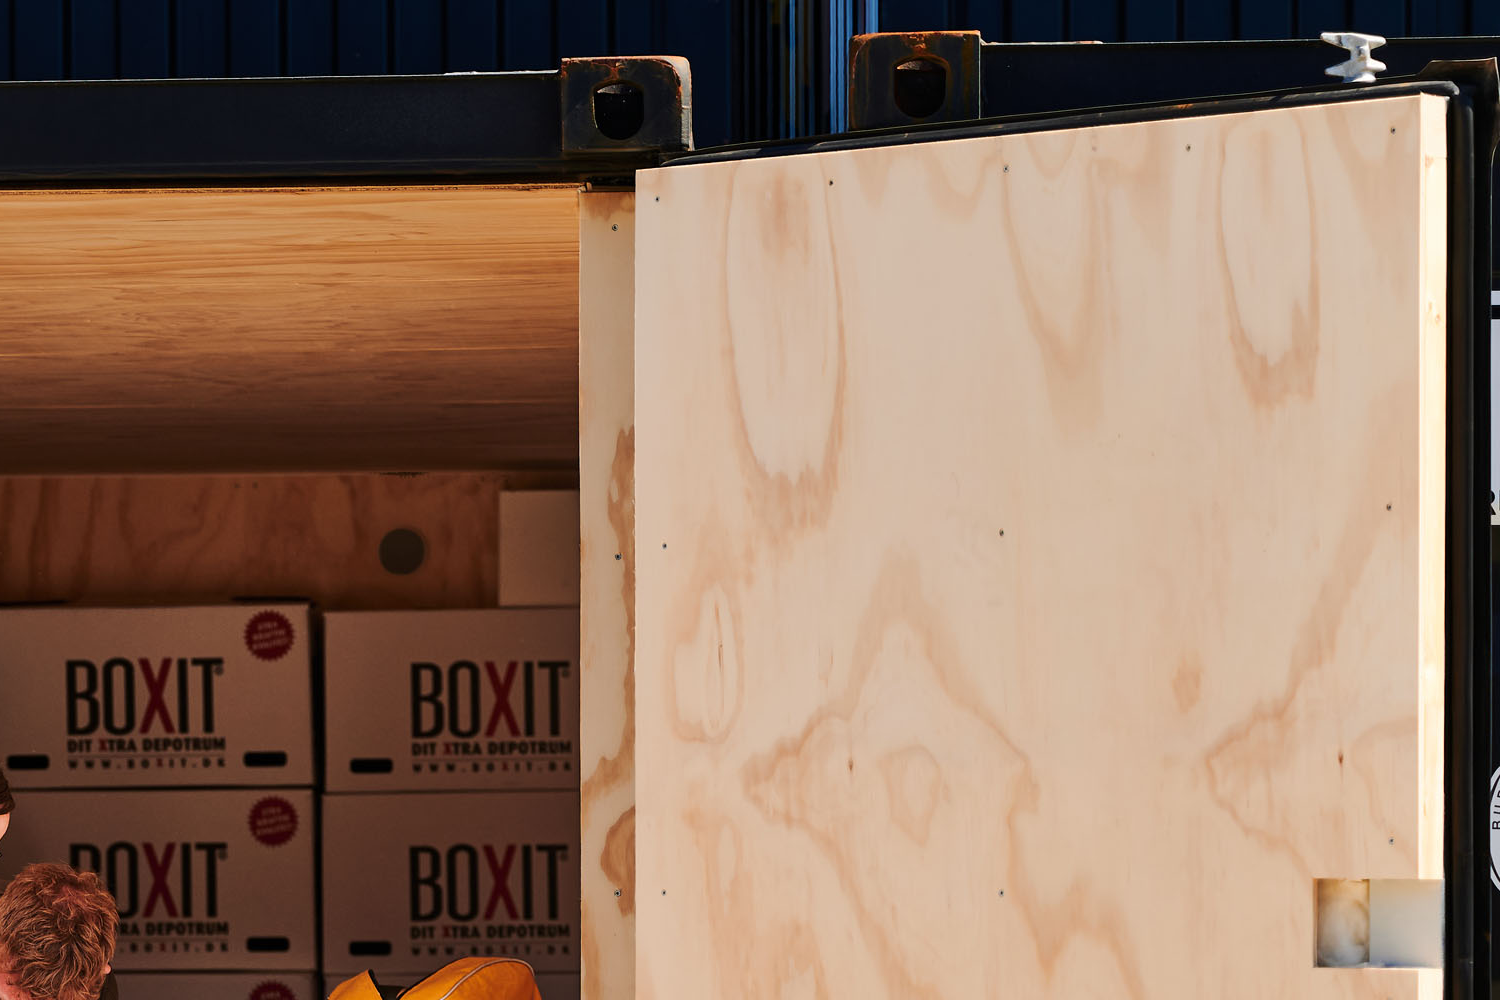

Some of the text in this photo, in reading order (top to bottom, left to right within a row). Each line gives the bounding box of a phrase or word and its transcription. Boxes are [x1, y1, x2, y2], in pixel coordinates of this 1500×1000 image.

[67, 738, 225, 753] DIT XTRA DEPOTRUM
[412, 741, 571, 756] DIT XTRA DEPOTRUM
[118, 922, 229, 936] RA DEPOTRUM
[410, 925, 570, 940] DIT XTRA DEPOTRUM
